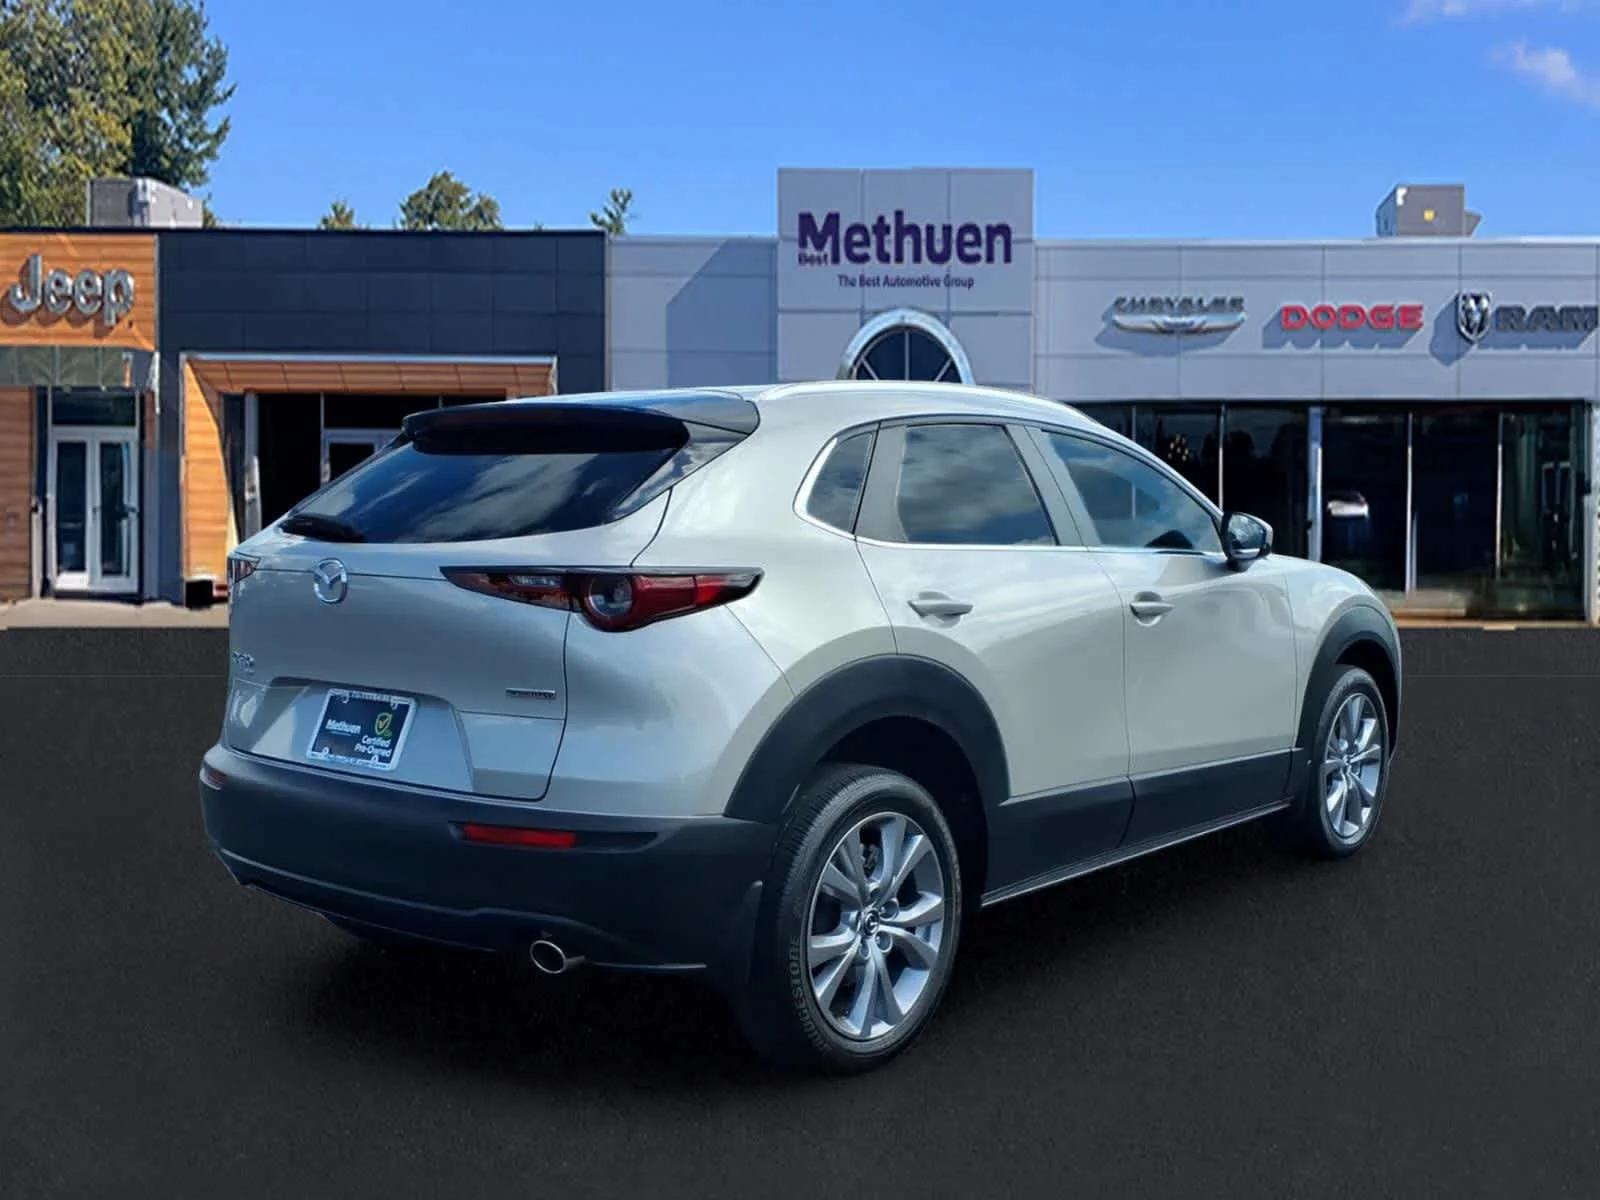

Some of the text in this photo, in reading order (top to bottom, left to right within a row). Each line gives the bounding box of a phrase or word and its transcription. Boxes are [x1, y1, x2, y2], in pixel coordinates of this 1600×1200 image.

[798, 209, 1012, 264] Methuen
[10, 254, 135, 326] Jeep
[837, 273, 975, 290] The Best Automotive Group
[1114, 296, 1246, 313] CHRYSLER
[1281, 303, 1424, 330] DODGE
[1495, 304, 1599, 333] RAM
[325, 719, 361, 734] Methuen
